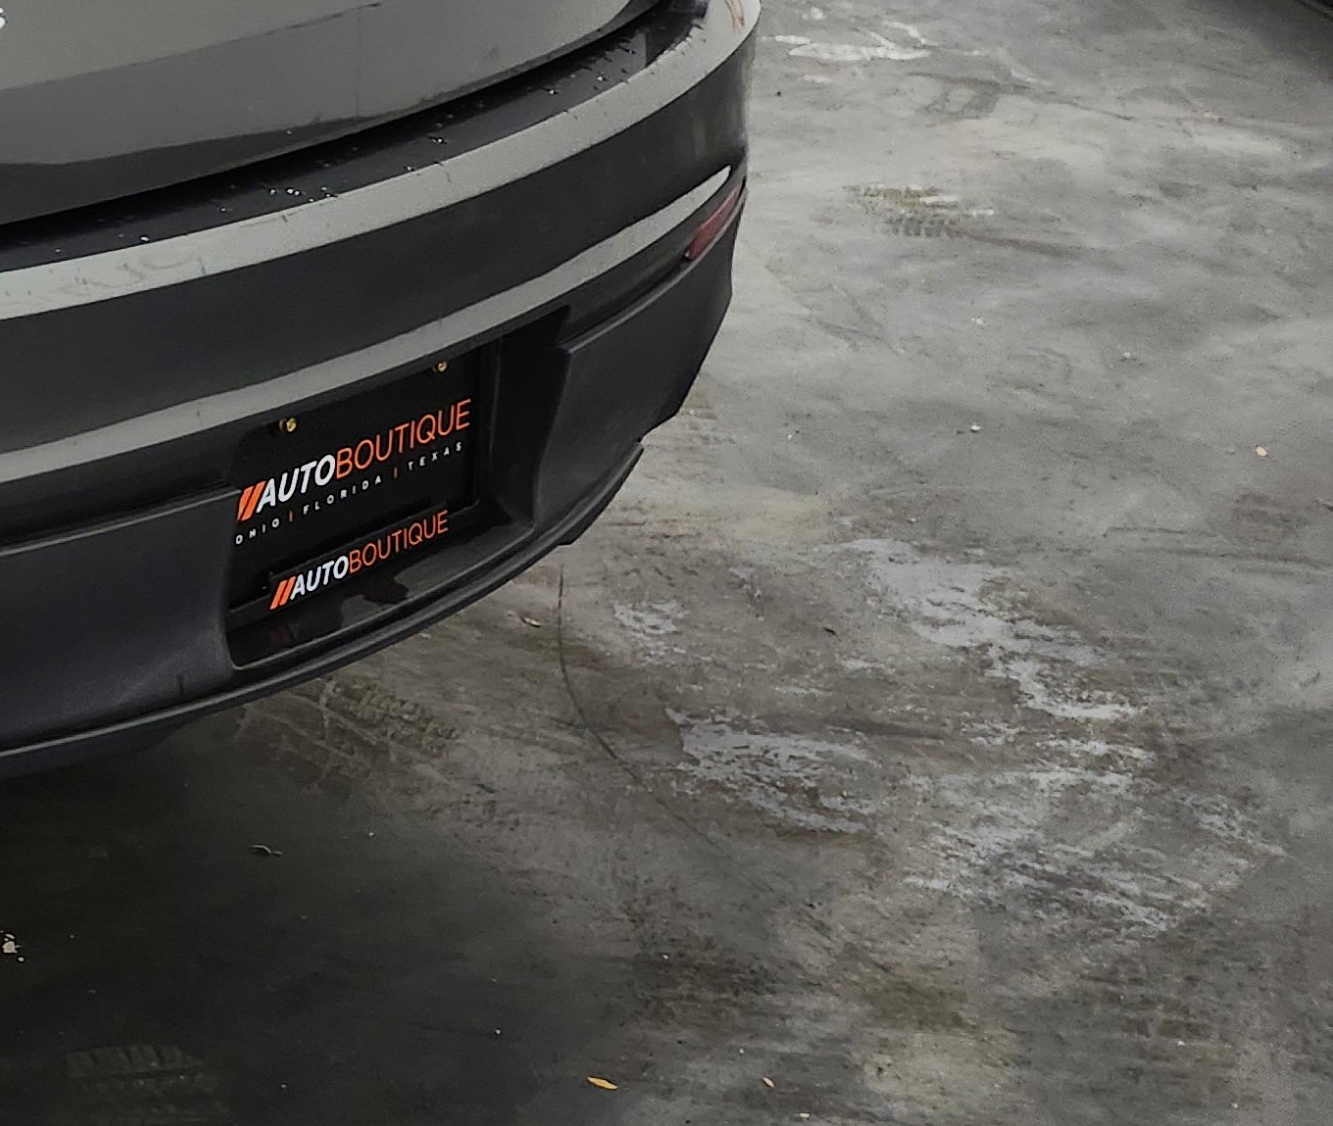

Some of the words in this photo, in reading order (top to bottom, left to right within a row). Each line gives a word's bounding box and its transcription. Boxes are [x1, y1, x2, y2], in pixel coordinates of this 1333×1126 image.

[235, 518, 279, 544] OHIO
[303, 476, 381, 514] FLORIDA
[408, 442, 462, 471] TEXAS
[256, 399, 471, 513] AUTOBOUTIQUE
[290, 510, 448, 600] AUTOBOUTIQUE
